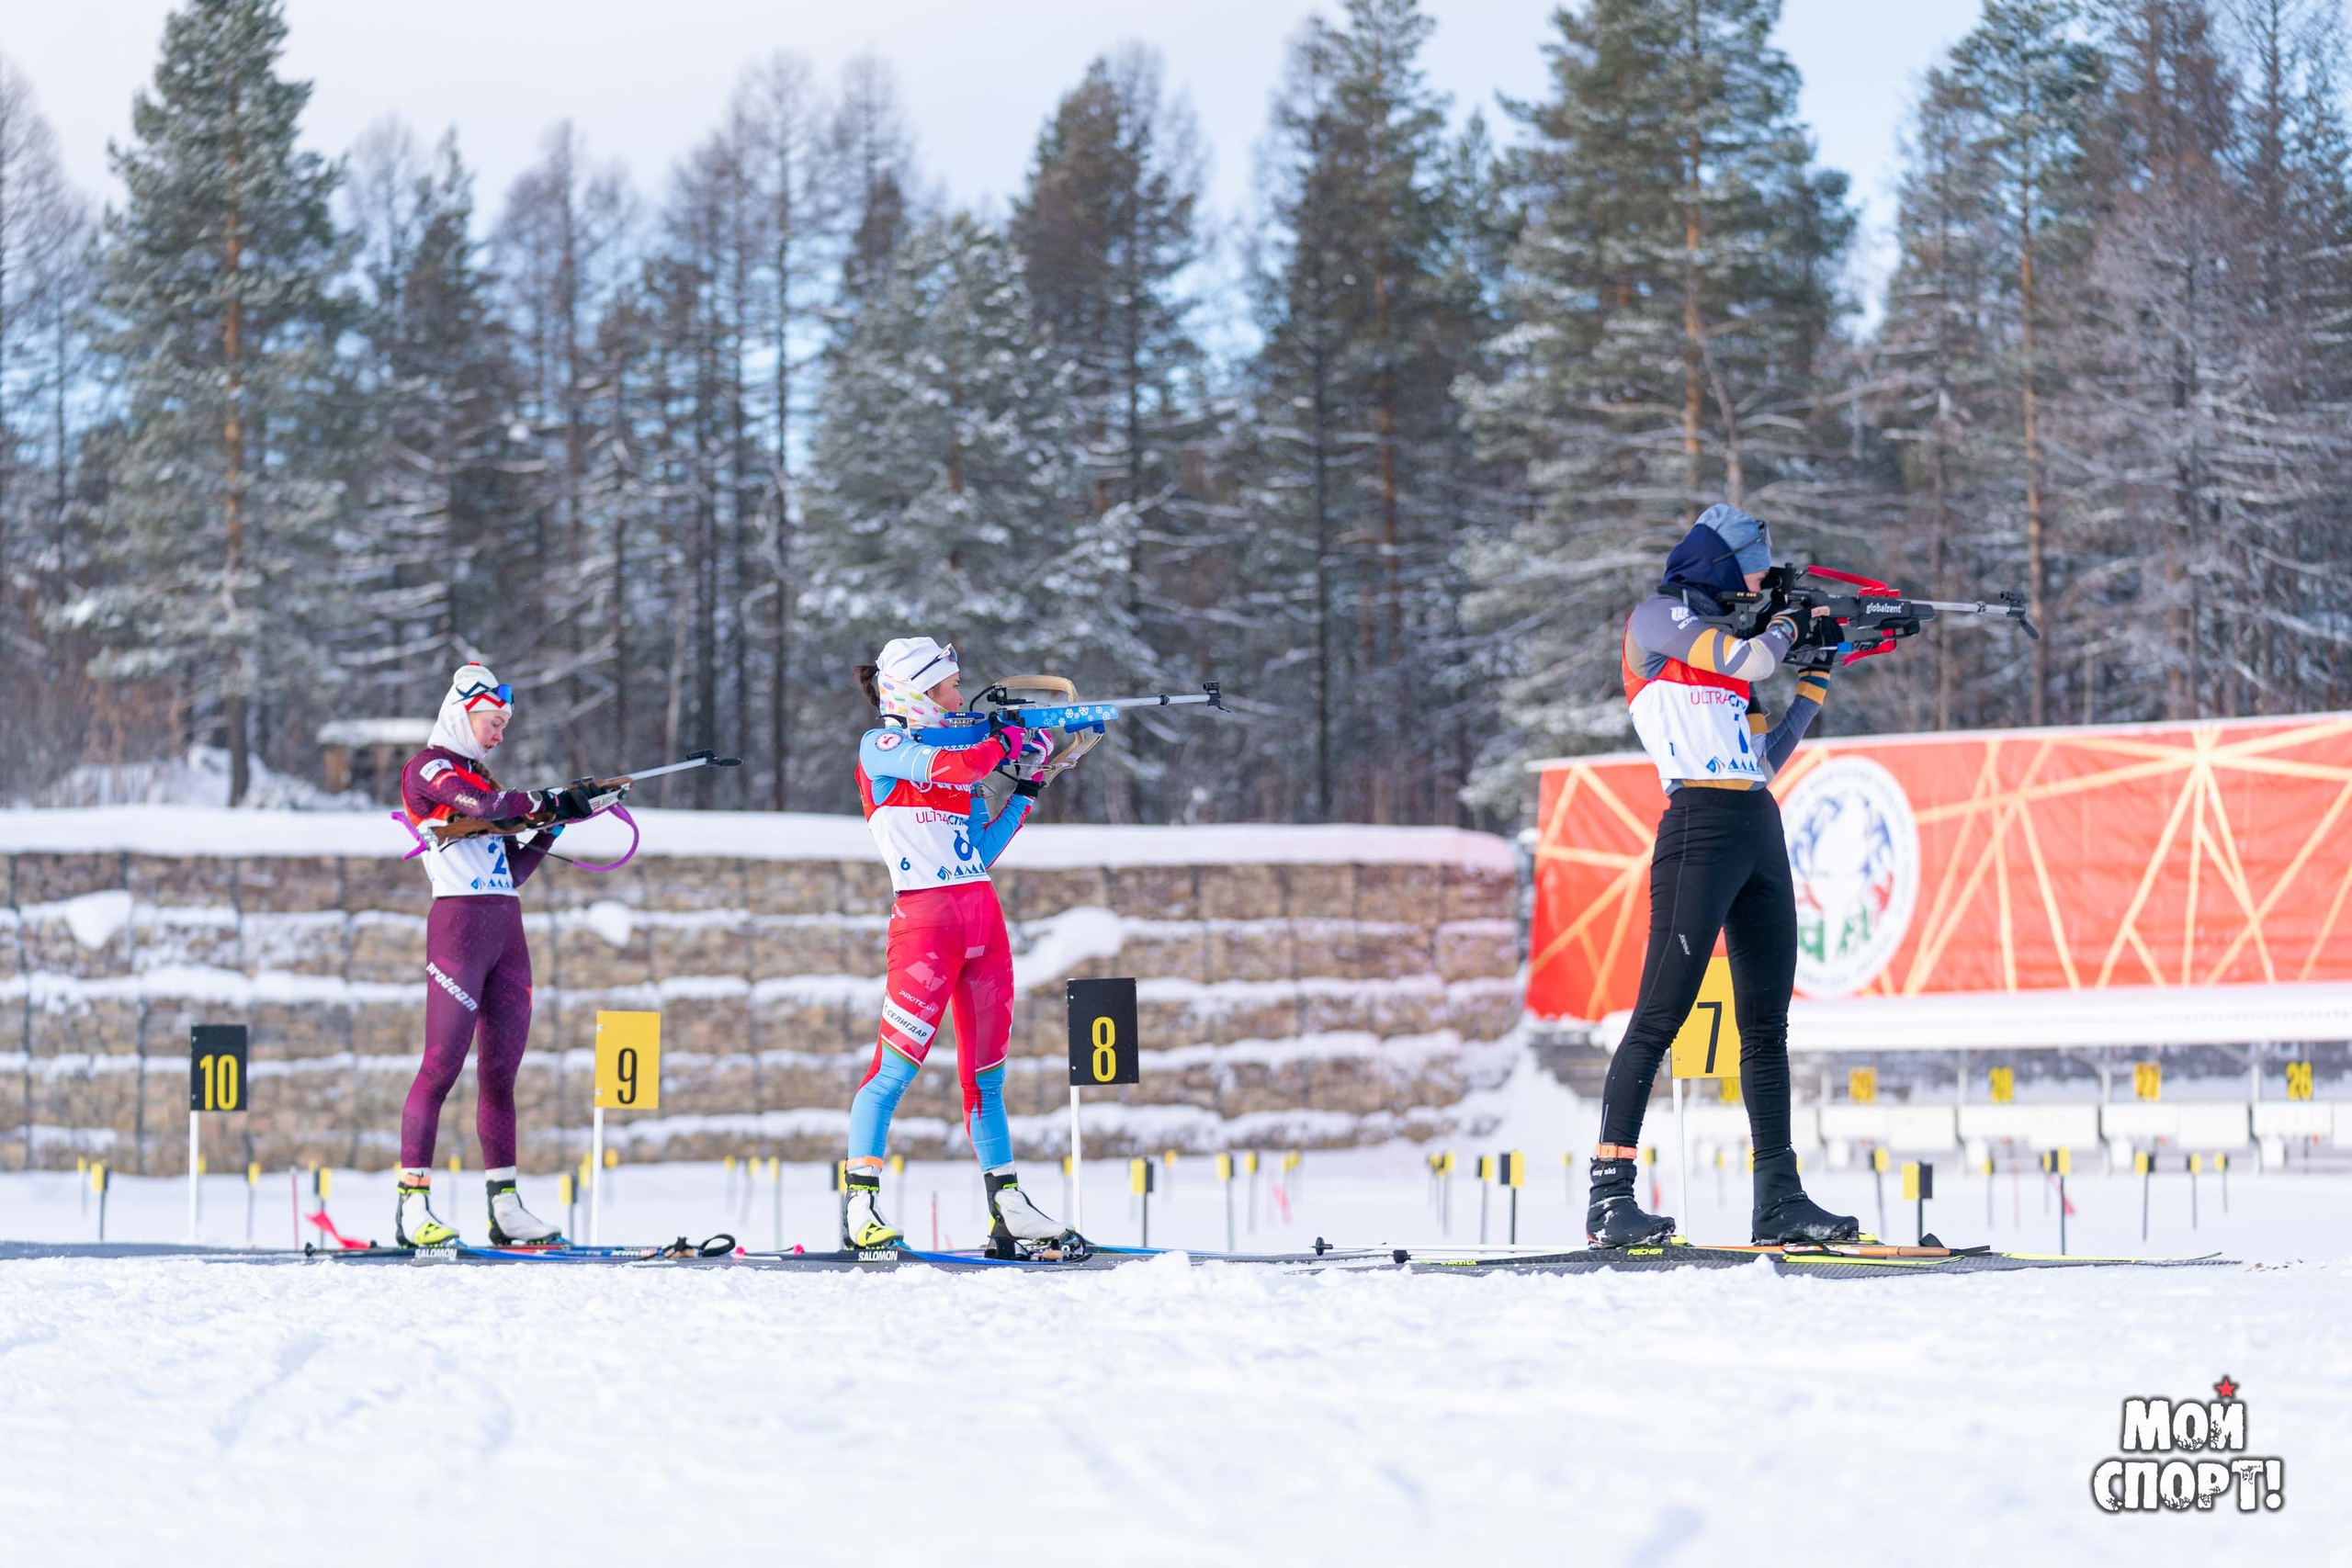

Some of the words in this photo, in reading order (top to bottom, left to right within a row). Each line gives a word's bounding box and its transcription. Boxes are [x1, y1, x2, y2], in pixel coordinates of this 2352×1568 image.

[1866, 602, 1902, 615] globalrent
[488, 841, 507, 875] 2
[953, 829, 974, 862] 6
[900, 857, 911, 872] 6
[887, 1010, 928, 1038] СЕЛИГДАР
[1697, 1001, 1723, 1074] 7
[1091, 1016, 1116, 1082] 8
[199, 1053, 238, 1111] 10
[617, 1047, 638, 1105] 9
[2285, 1061, 2312, 1100] 26
[414, 1249, 458, 1261] SALOMON
[858, 1250, 899, 1261] SALOMON
